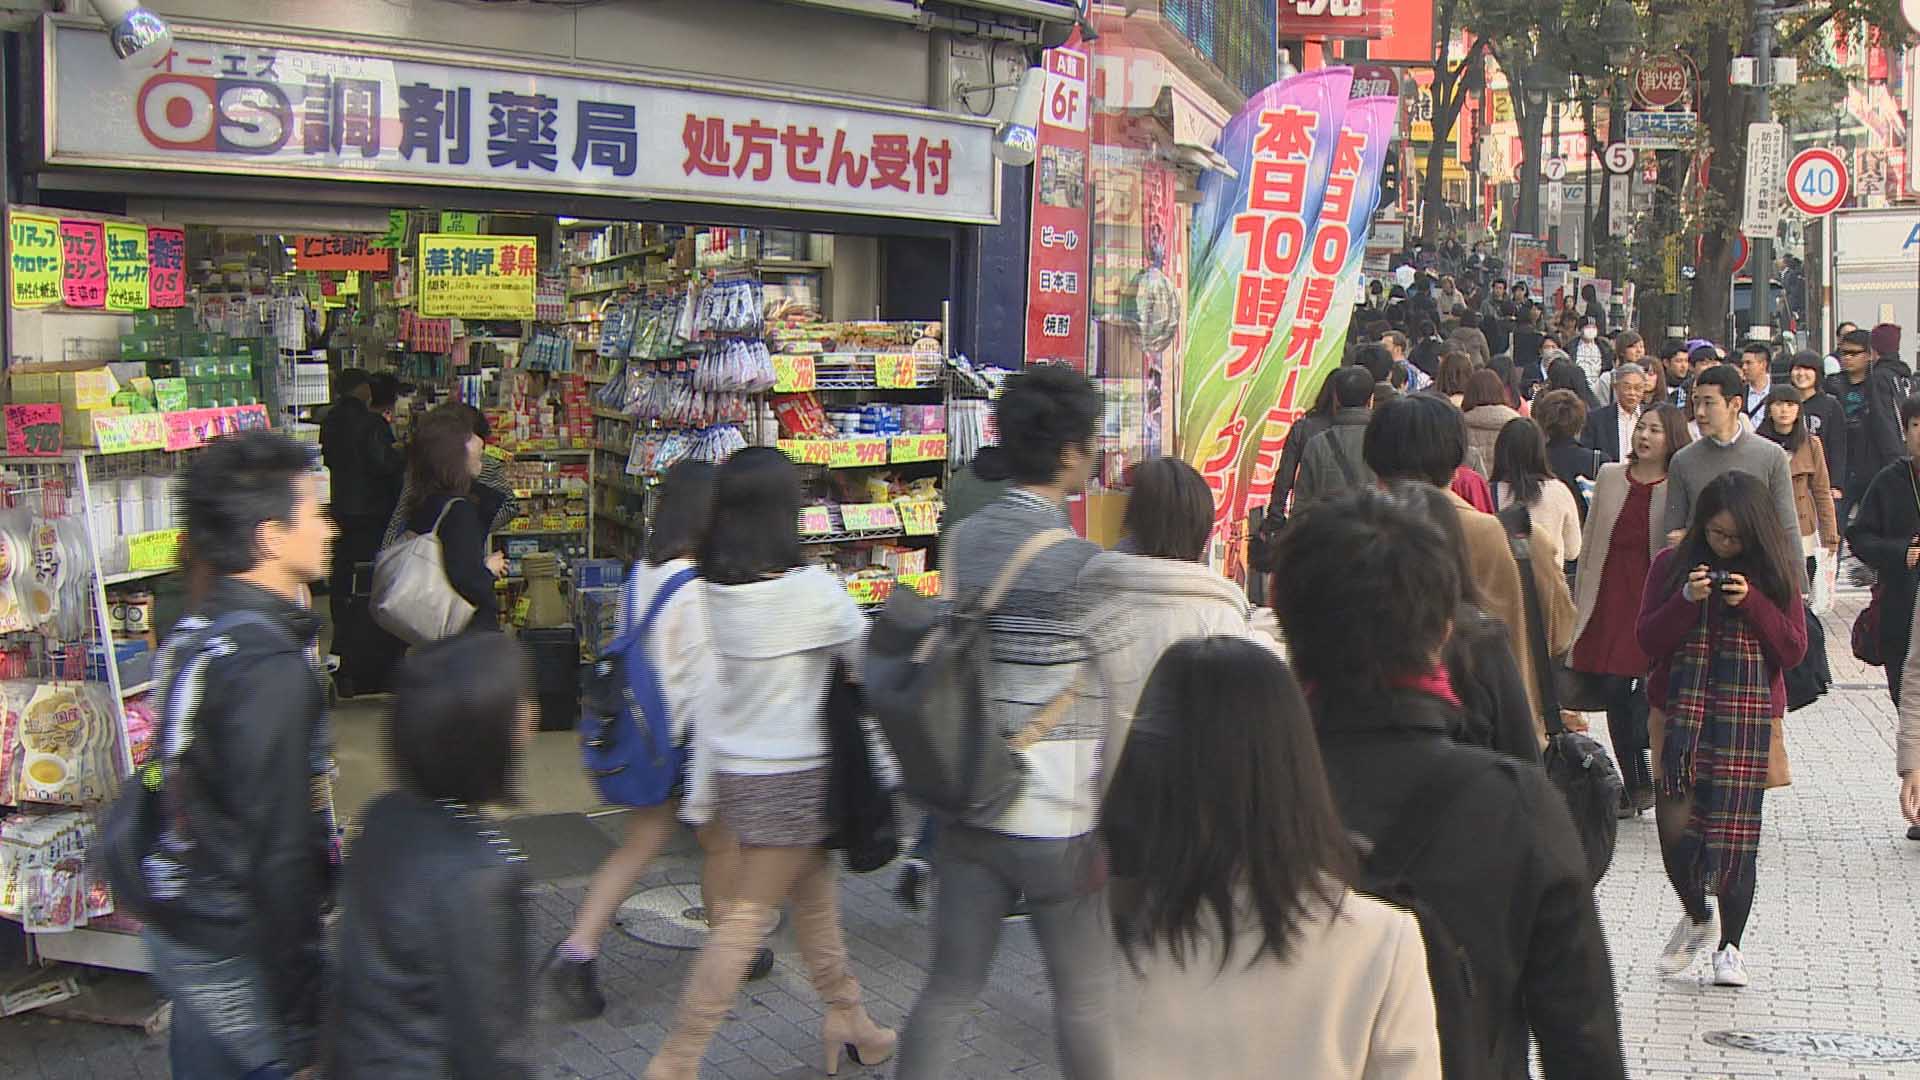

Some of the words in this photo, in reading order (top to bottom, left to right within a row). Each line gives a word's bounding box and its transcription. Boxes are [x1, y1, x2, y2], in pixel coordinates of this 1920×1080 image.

[1641, 70, 1683, 92] 消火栓
[1051, 80, 1079, 123] 6F
[681, 112, 952, 196] 処方せん受付
[1613, 147, 1627, 168] 5
[1550, 160, 1561, 177] 7
[1757, 131, 1772, 220] 防犯カメラ作動中
[1800, 167, 1835, 197] 40
[1040, 226, 1079, 250] ビール
[153, 272, 178, 292] OS
[1038, 271, 1078, 294] 日本酒
[1043, 315, 1071, 337] 焼酎
